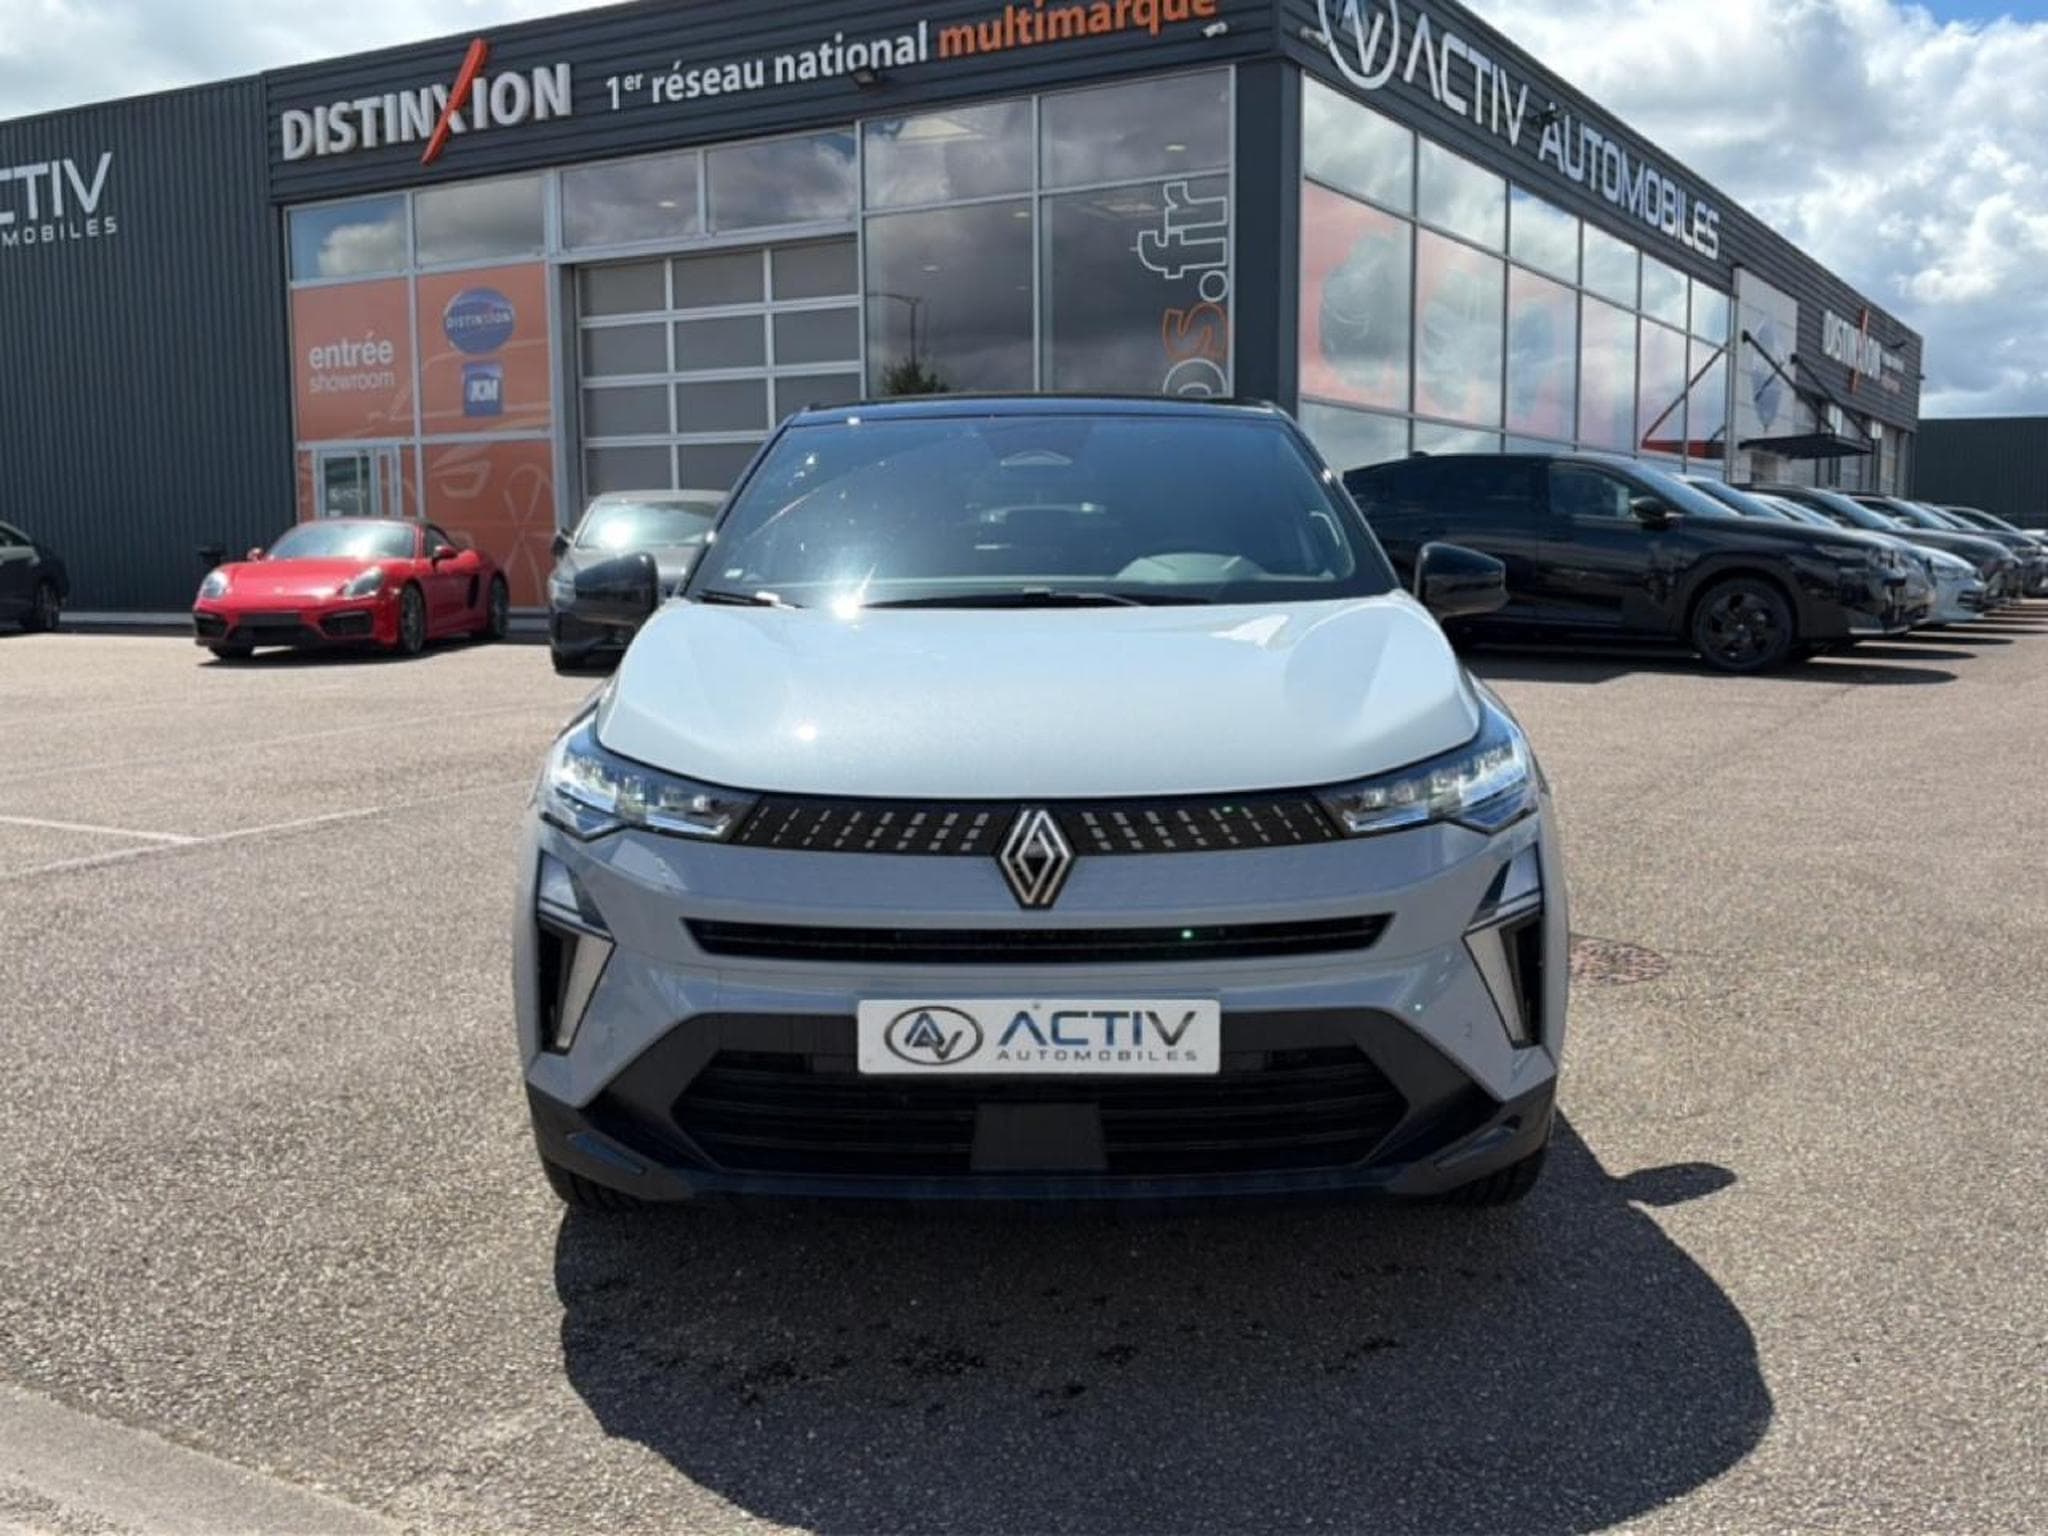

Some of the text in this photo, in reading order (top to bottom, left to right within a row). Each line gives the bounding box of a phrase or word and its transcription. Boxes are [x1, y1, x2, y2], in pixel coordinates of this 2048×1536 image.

[606, 73, 643, 110] 1er
[652, 60, 764, 104] réseau
[774, 20, 928, 84] national
[282, 37, 573, 166] DISTINXION
[1403, 12, 1529, 147] ACTIV
[1538, 102, 1720, 260] AUTOMOBILES
[1, 216, 118, 248] MOBILES
[309, 331, 394, 369] entrée
[309, 369, 395, 394] showroom
[997, 1010, 1196, 1047] ACTIV
[997, 1049, 1197, 1062] AUTOMOBILES
